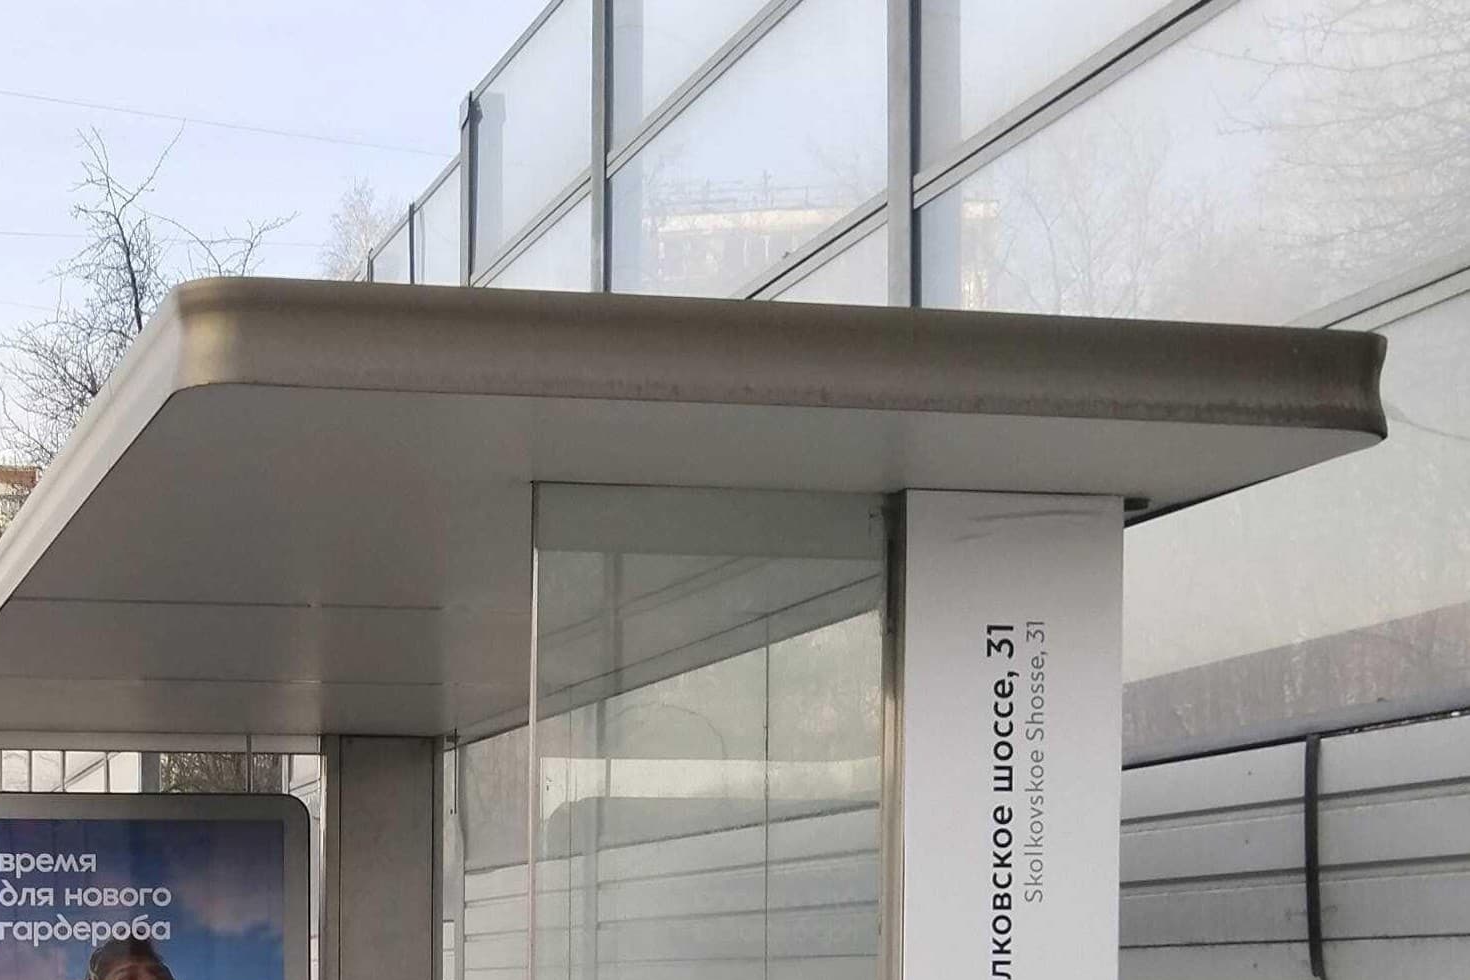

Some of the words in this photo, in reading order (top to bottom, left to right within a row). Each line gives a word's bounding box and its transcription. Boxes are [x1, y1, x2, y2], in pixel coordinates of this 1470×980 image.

[986, 624, 1014, 658] 31
[1026, 620, 1045, 643] 31
[1025, 650, 1049, 742] Shosse,
[992, 670, 1020, 793] шоссе,
[1024, 753, 1045, 903] Skolkovskoe
[65, 887, 172, 907] нового
